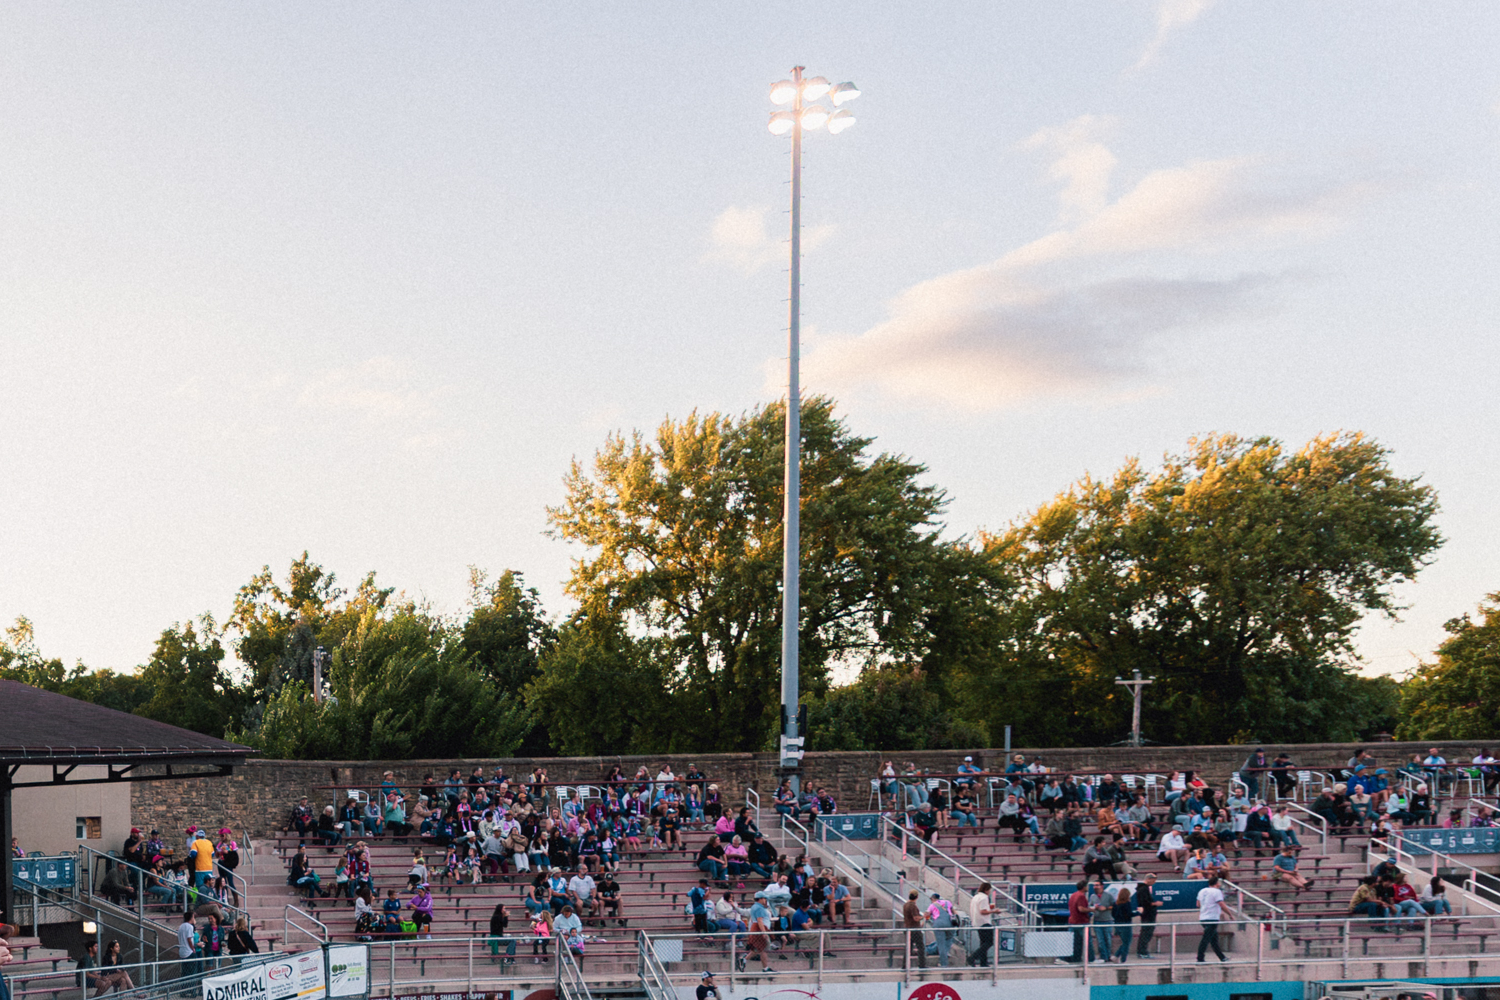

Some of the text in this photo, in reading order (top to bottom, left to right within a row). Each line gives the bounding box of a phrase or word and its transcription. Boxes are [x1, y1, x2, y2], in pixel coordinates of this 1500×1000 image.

[1449, 836, 1456, 848] 5
[35, 869, 40, 882] 4
[440, 993, 463, 1000] SHAKES
